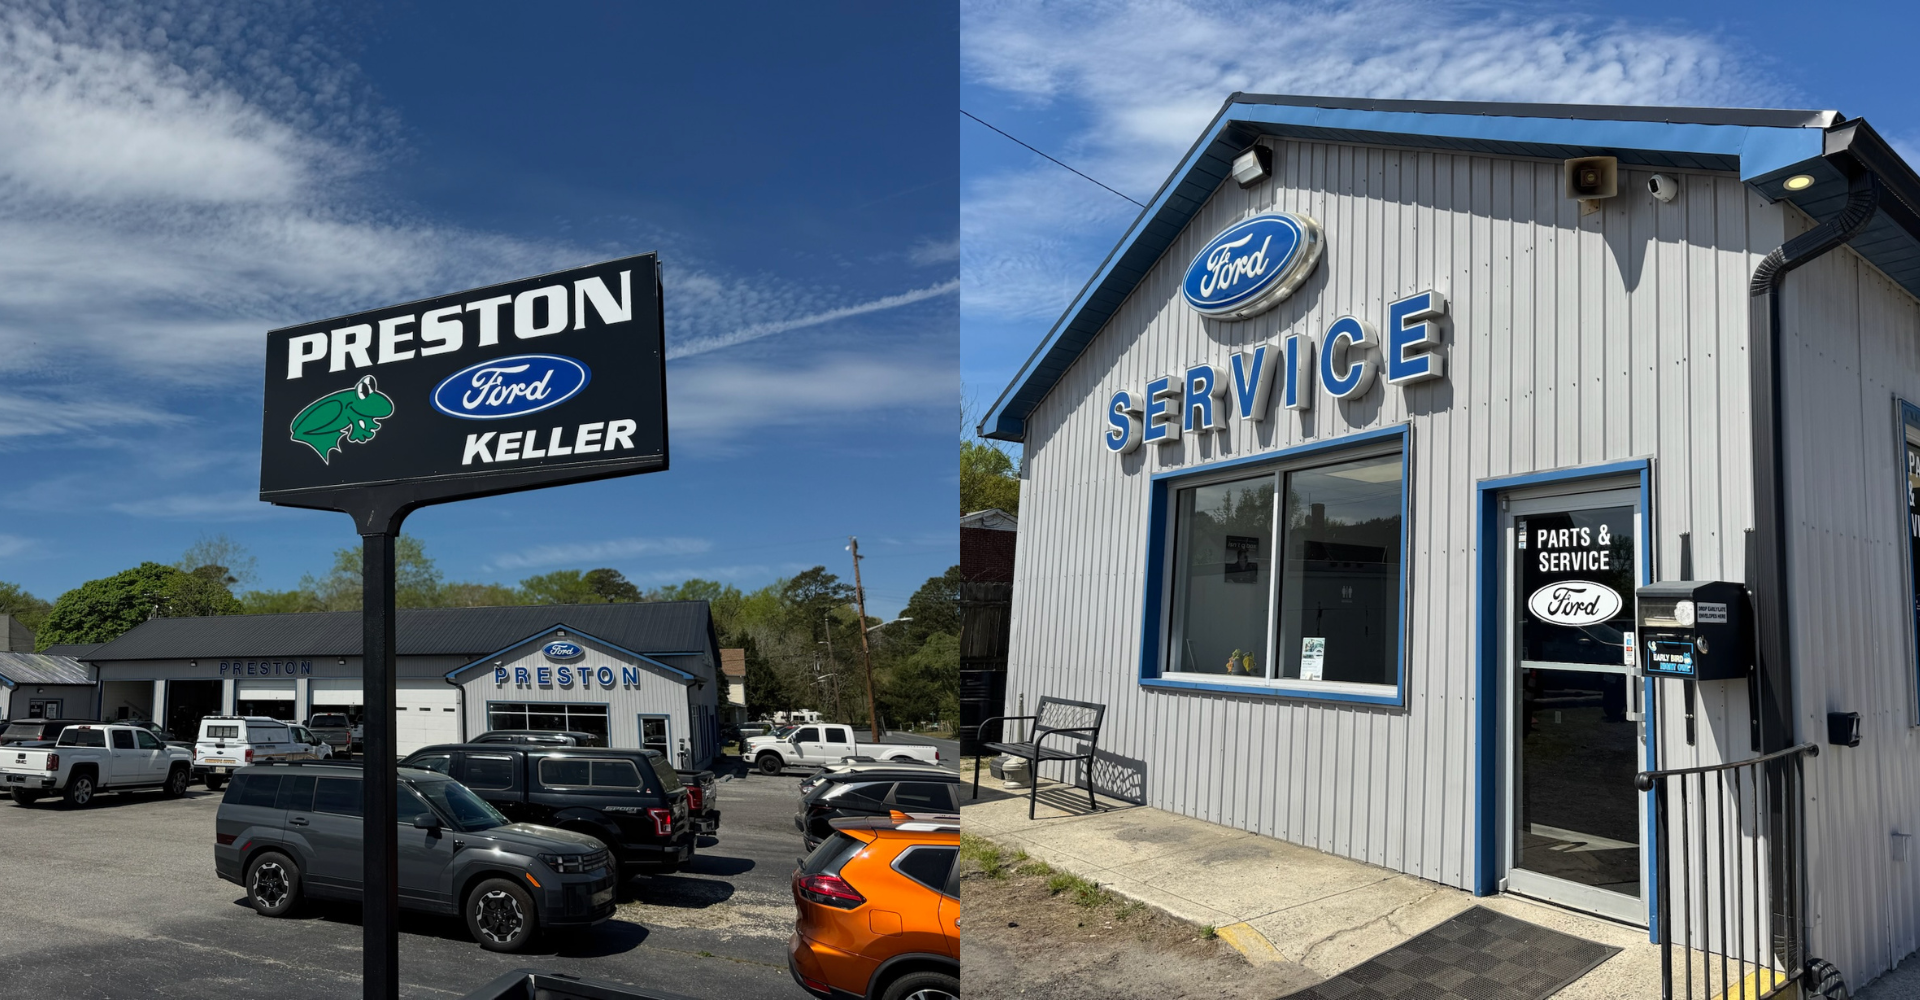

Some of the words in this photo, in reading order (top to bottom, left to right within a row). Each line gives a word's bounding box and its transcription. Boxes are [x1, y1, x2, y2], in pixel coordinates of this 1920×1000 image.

[1200, 233, 1272, 299] Ford
[286, 270, 632, 380] PRESTON
[1105, 289, 1444, 454] SERVICE
[463, 363, 555, 410] Ford
[462, 418, 637, 466] KELLER
[1537, 526, 1591, 549] PARTS
[1598, 524, 1611, 546] &
[1539, 550, 1610, 572] SERVICE
[1547, 587, 1601, 616] Ford
[550, 644, 574, 656] Ford
[1653, 653, 1670, 662] EARLY
[1670, 654, 1684, 663] BIRD
[219, 660, 312, 676] PRESTON
[494, 666, 639, 686] PRESTON
